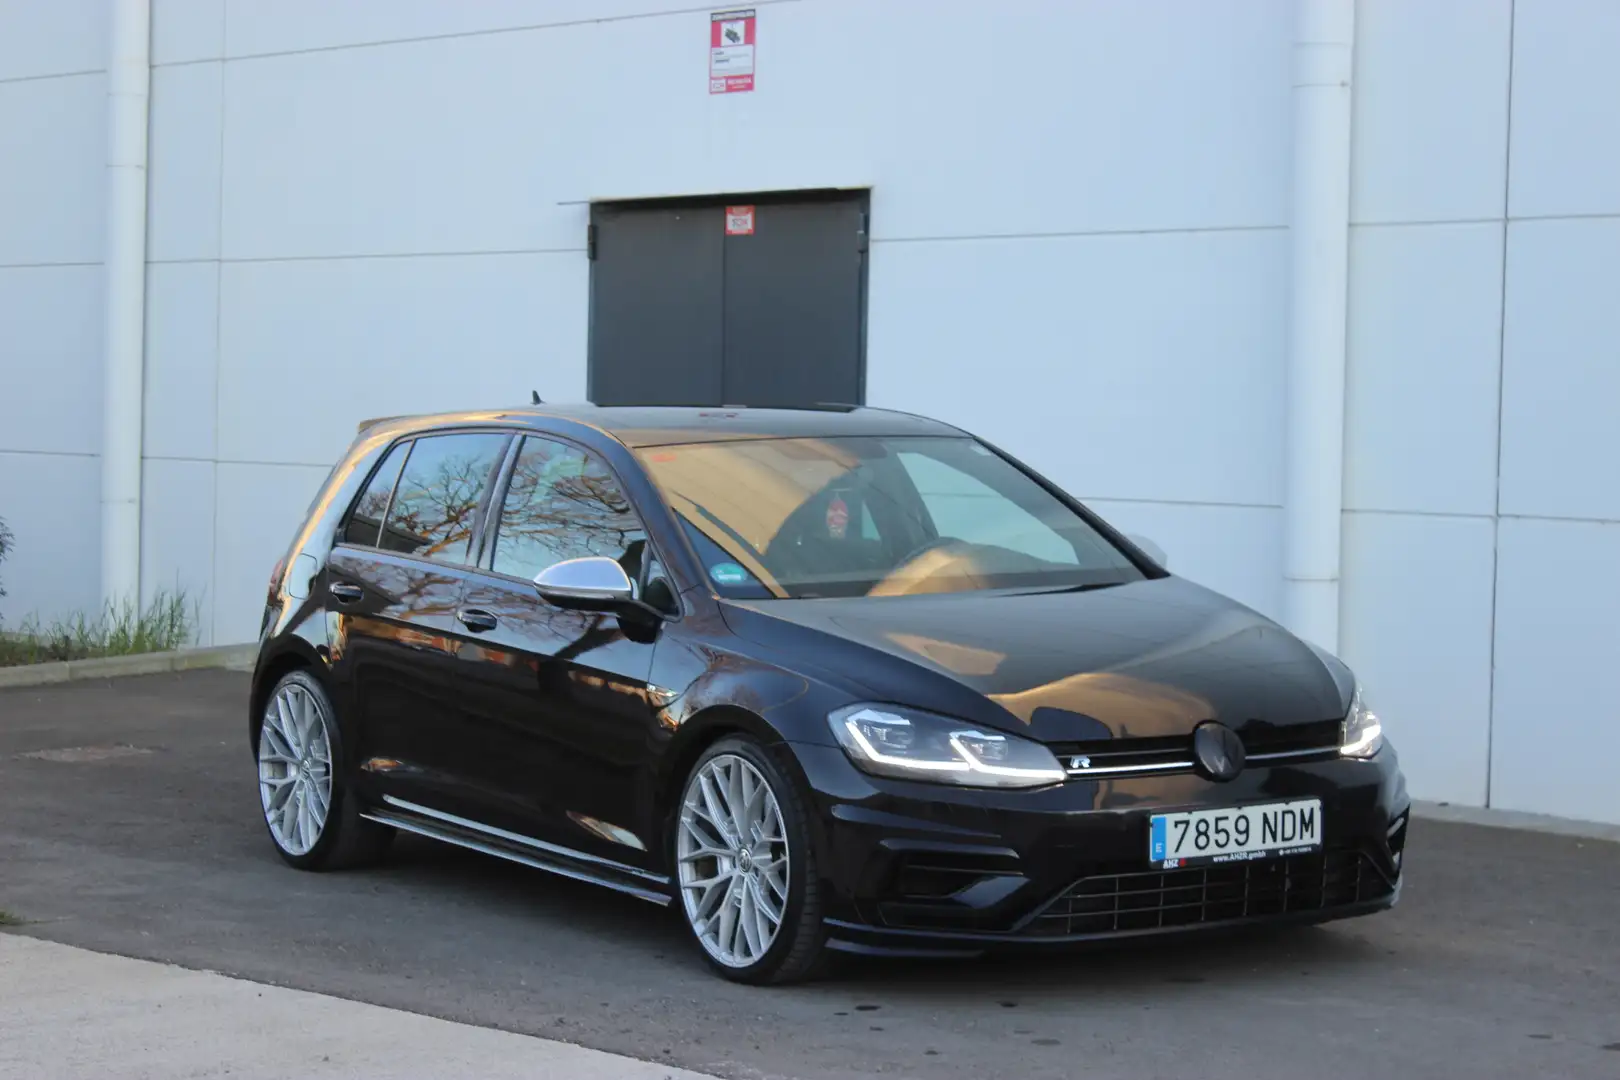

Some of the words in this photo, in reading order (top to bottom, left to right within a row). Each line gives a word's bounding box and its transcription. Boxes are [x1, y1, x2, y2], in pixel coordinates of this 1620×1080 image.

[1173, 814, 1250, 853] 7859
[1262, 807, 1315, 845] NDM
[1155, 842, 1163, 853] E
